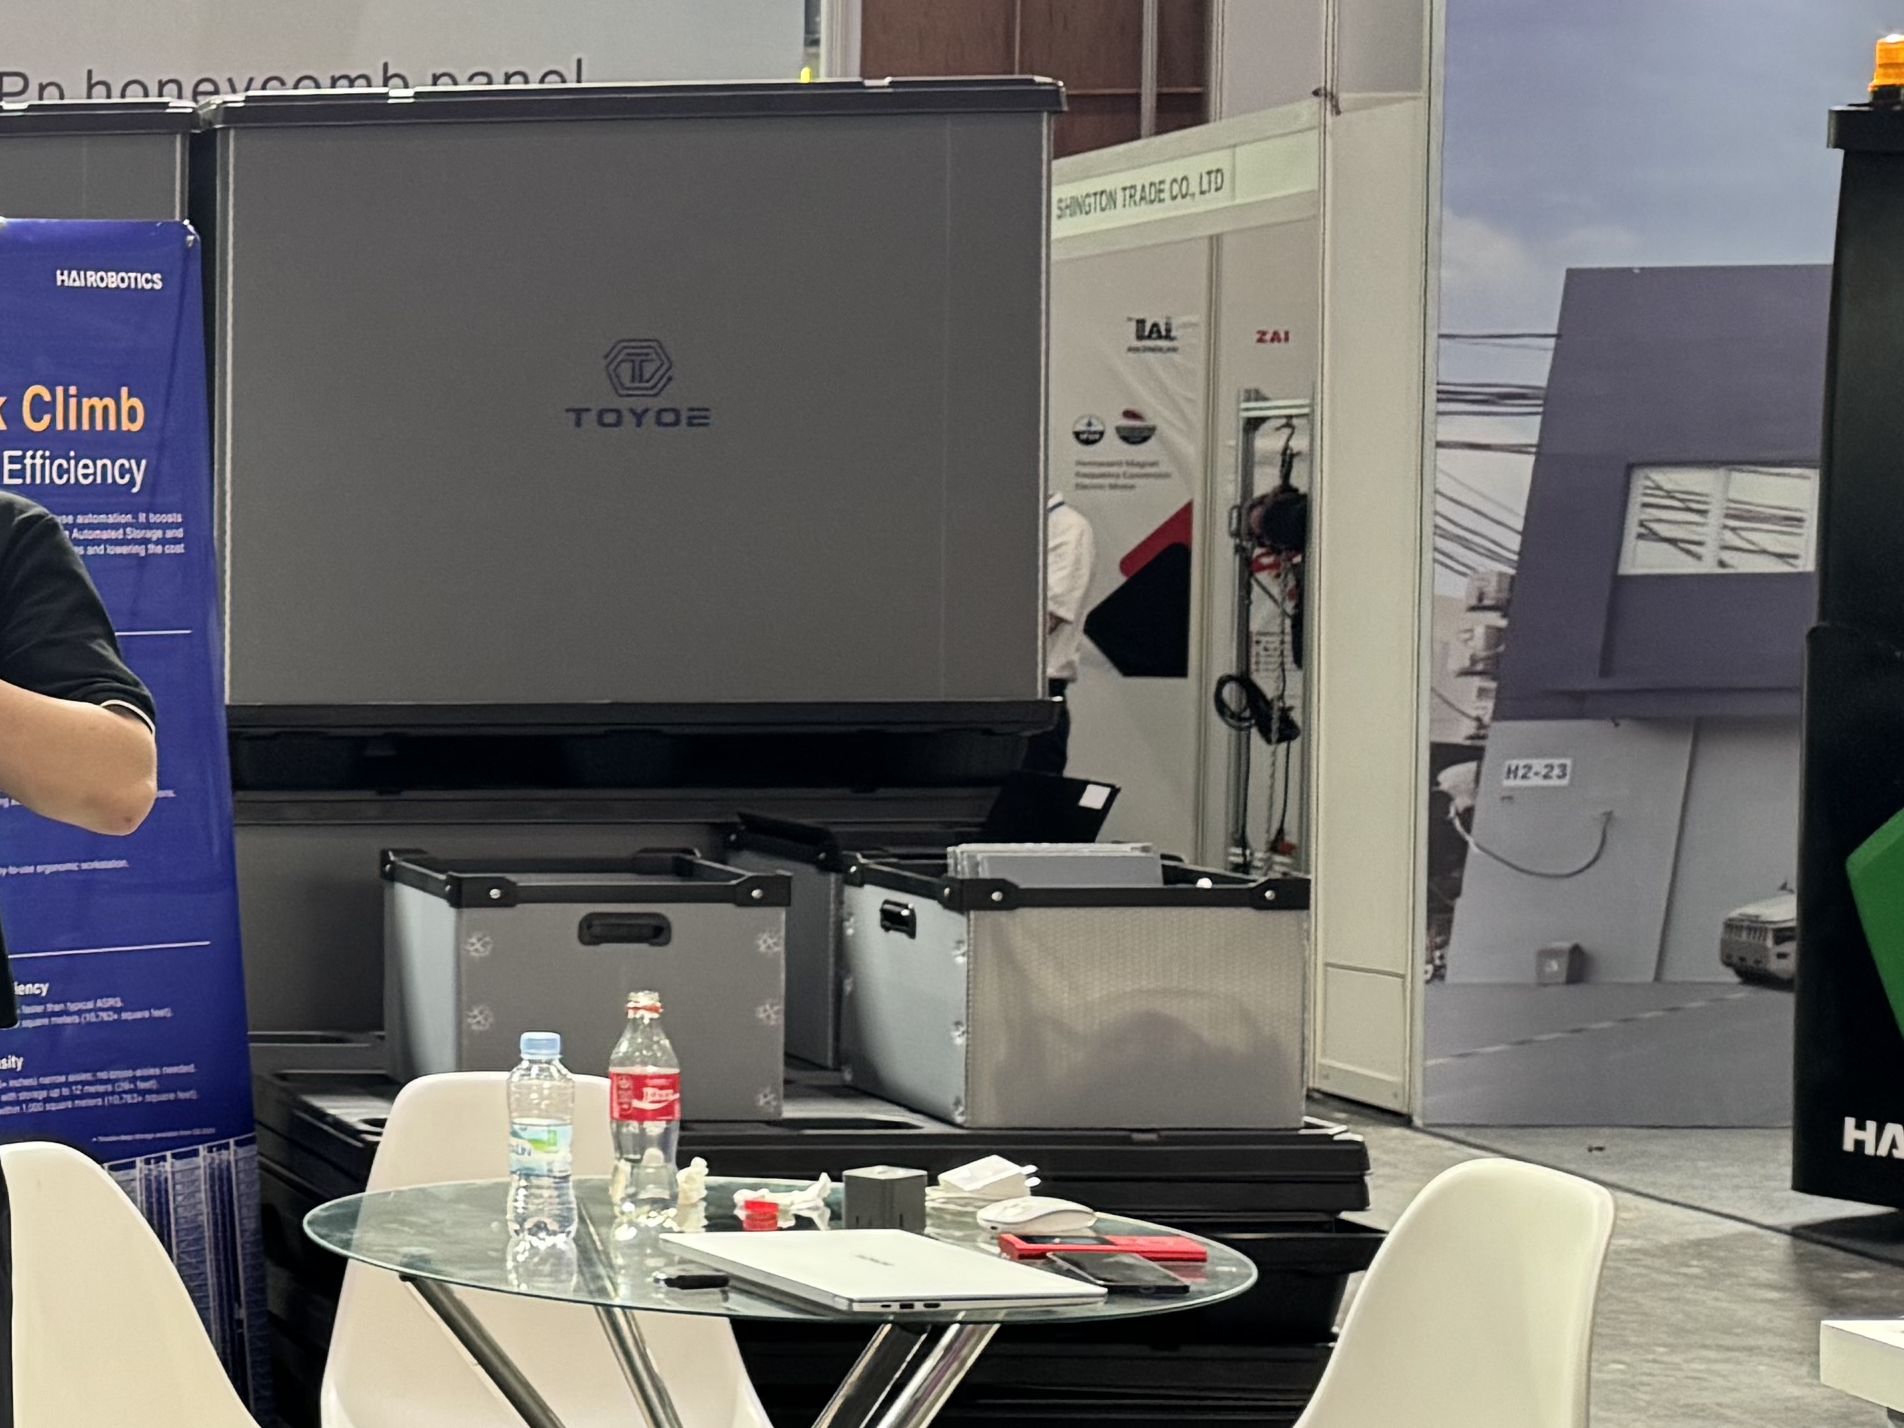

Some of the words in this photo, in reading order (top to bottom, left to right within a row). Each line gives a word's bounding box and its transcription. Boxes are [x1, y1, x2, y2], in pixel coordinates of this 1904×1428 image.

[1120, 178, 1167, 210] TRADE
[1198, 167, 1225, 197] LTD
[1254, 329, 1291, 345] ZAI
[21, 383, 147, 433] Climb
[564, 406, 713, 429] TOYOE
[1, 449, 148, 494] Efficiency
[1503, 762, 1570, 782] H2-23
